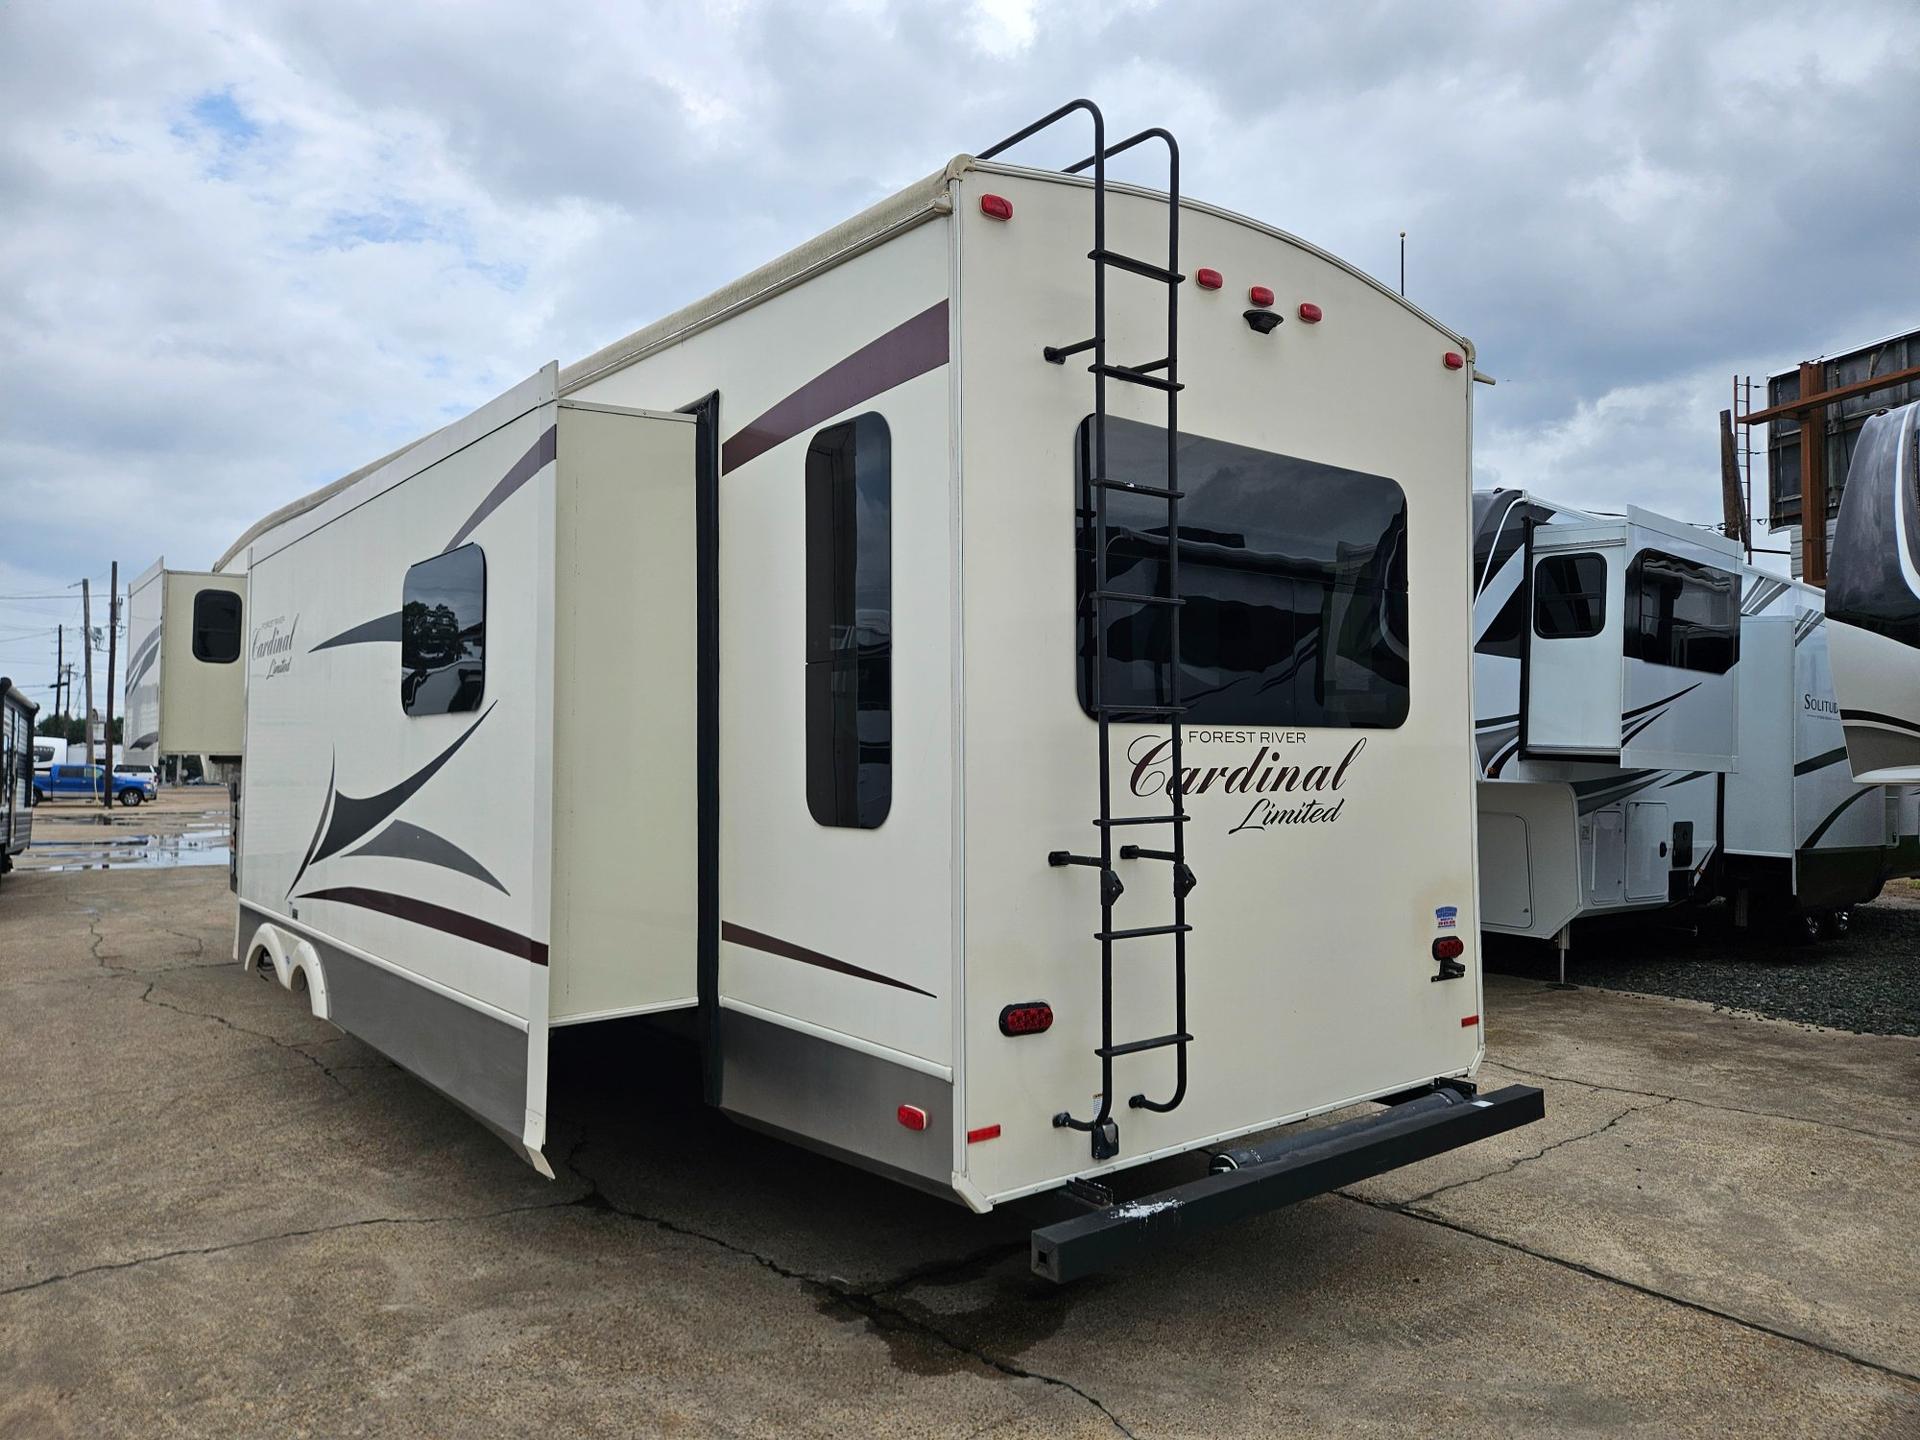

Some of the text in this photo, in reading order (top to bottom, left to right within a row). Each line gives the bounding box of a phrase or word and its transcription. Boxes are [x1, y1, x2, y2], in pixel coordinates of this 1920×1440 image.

[252, 613, 299, 660] Cardinal
[1804, 693, 1839, 714] SOLITUD
[1188, 730, 1307, 744] FOREST RIVER
[1127, 734, 1367, 797] Cardinal
[1228, 798, 1345, 835] Limited
